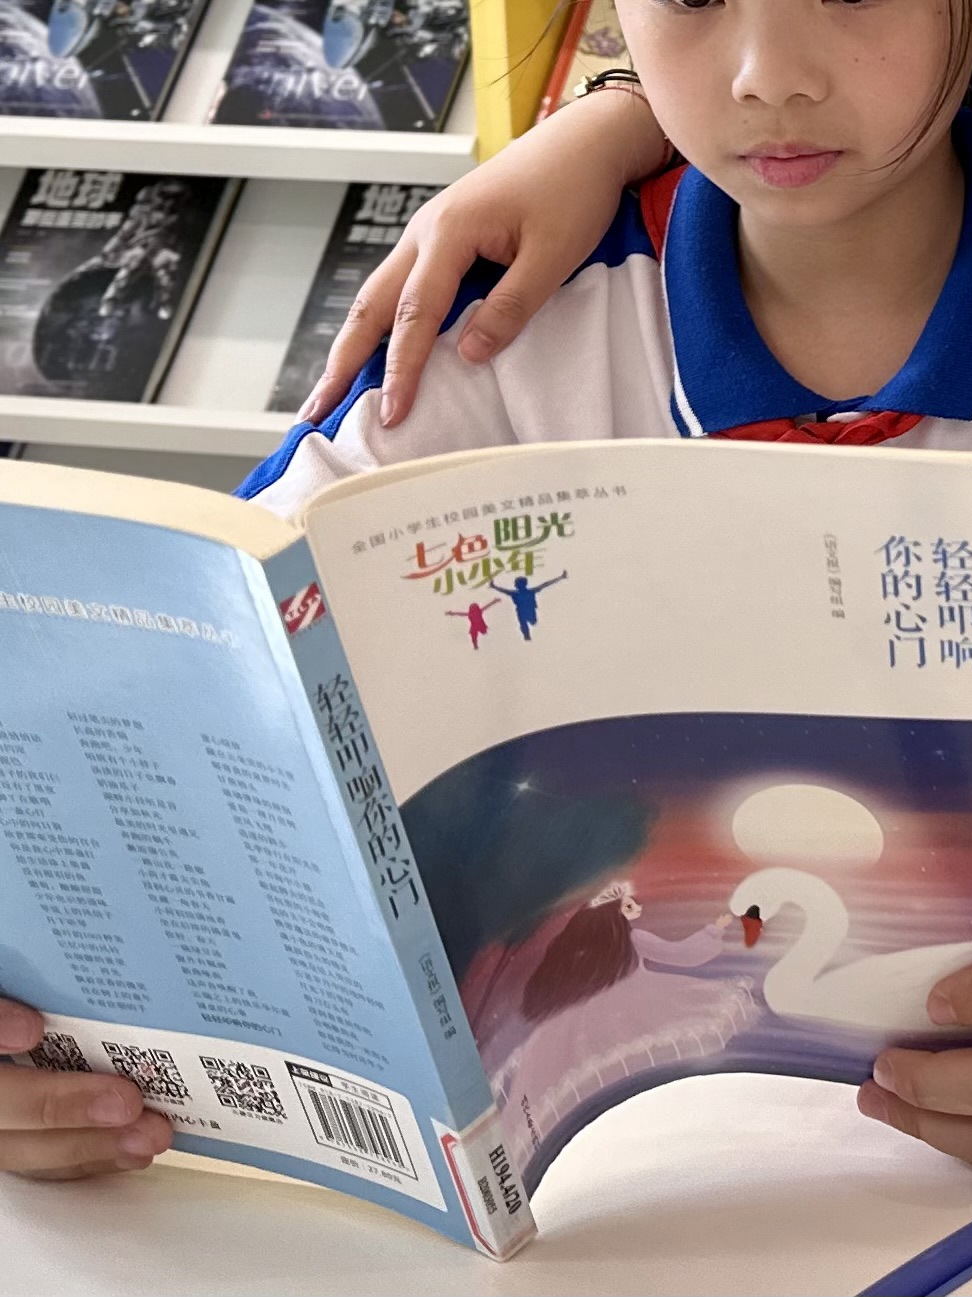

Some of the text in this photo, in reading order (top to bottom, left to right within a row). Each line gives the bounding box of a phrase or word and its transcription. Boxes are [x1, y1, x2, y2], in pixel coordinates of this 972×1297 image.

[29, 171, 124, 208] 地球
[874, 535, 928, 669] 你的心门
[314, 672, 420, 921] 轻轻叩响你的心门
[488, 1143, 523, 1216] H194.4/20
